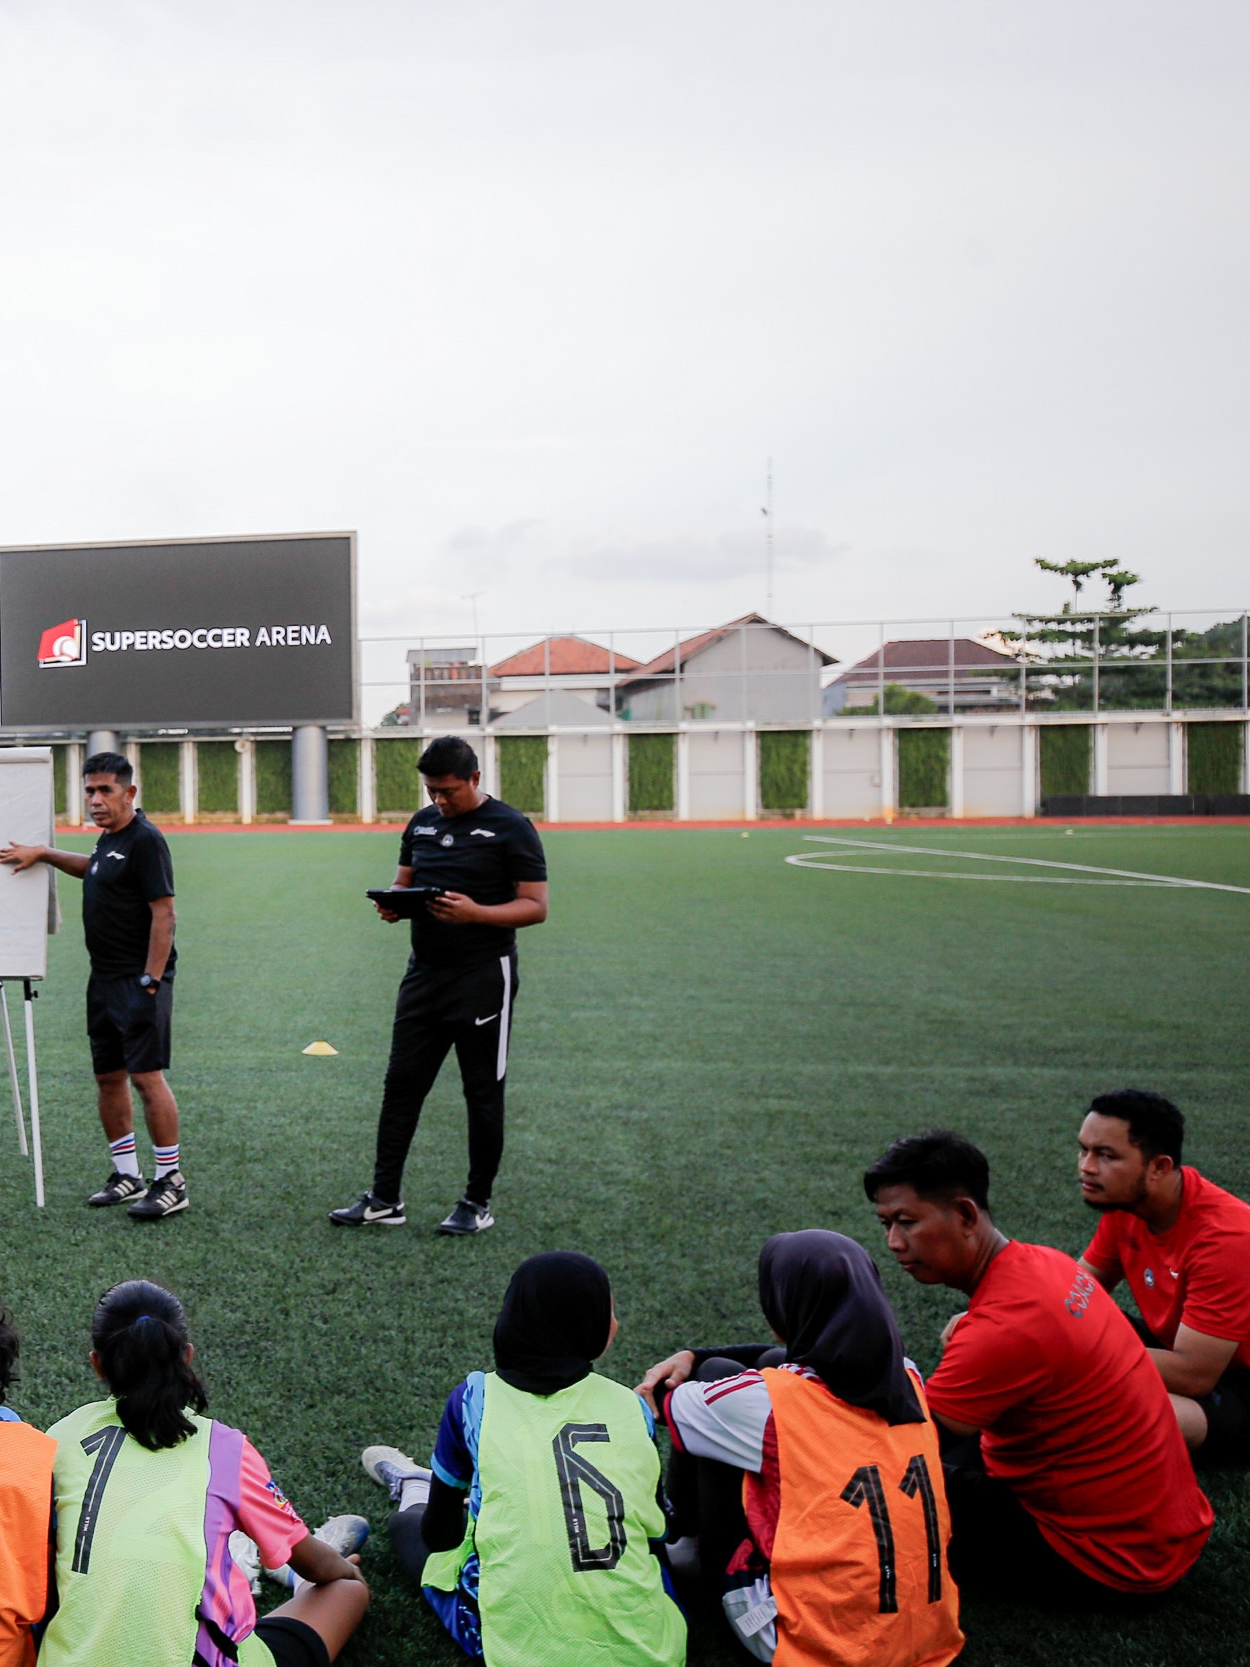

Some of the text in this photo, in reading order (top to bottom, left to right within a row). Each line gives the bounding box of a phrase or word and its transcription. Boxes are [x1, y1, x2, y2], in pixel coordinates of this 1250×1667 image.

[91, 624, 332, 652] SUPERSOCCER ARENA
[71, 1425, 128, 1575] 1
[552, 1423, 627, 1572] 6
[839, 1454, 942, 1613] 11
